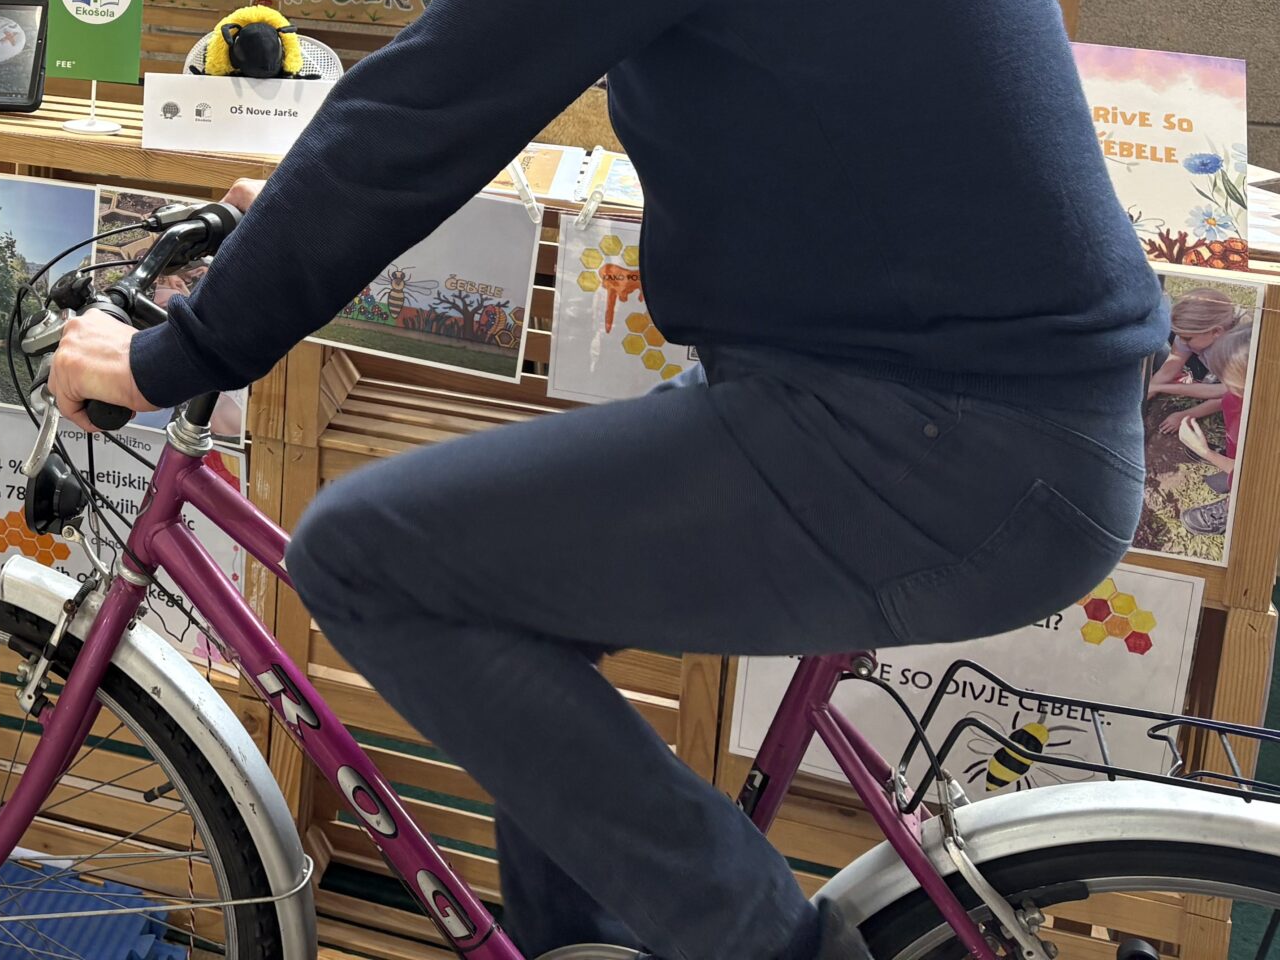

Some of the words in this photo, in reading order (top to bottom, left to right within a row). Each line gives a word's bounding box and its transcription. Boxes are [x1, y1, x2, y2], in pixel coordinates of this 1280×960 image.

[74, 6, 116, 19] Ekošola
[229, 104, 244, 116] OŠ
[246, 106, 272, 117] Nove
[273, 107, 299, 119] Jarše
[1092, 105, 1153, 129] RIVE
[1161, 112, 1194, 134] SO
[443, 273, 505, 299] ČEBELE
[8, 458, 26, 474] %
[5, 485, 27, 501] 78
[899, 667, 933, 690] SO
[944, 677, 1010, 708] DIVJE
